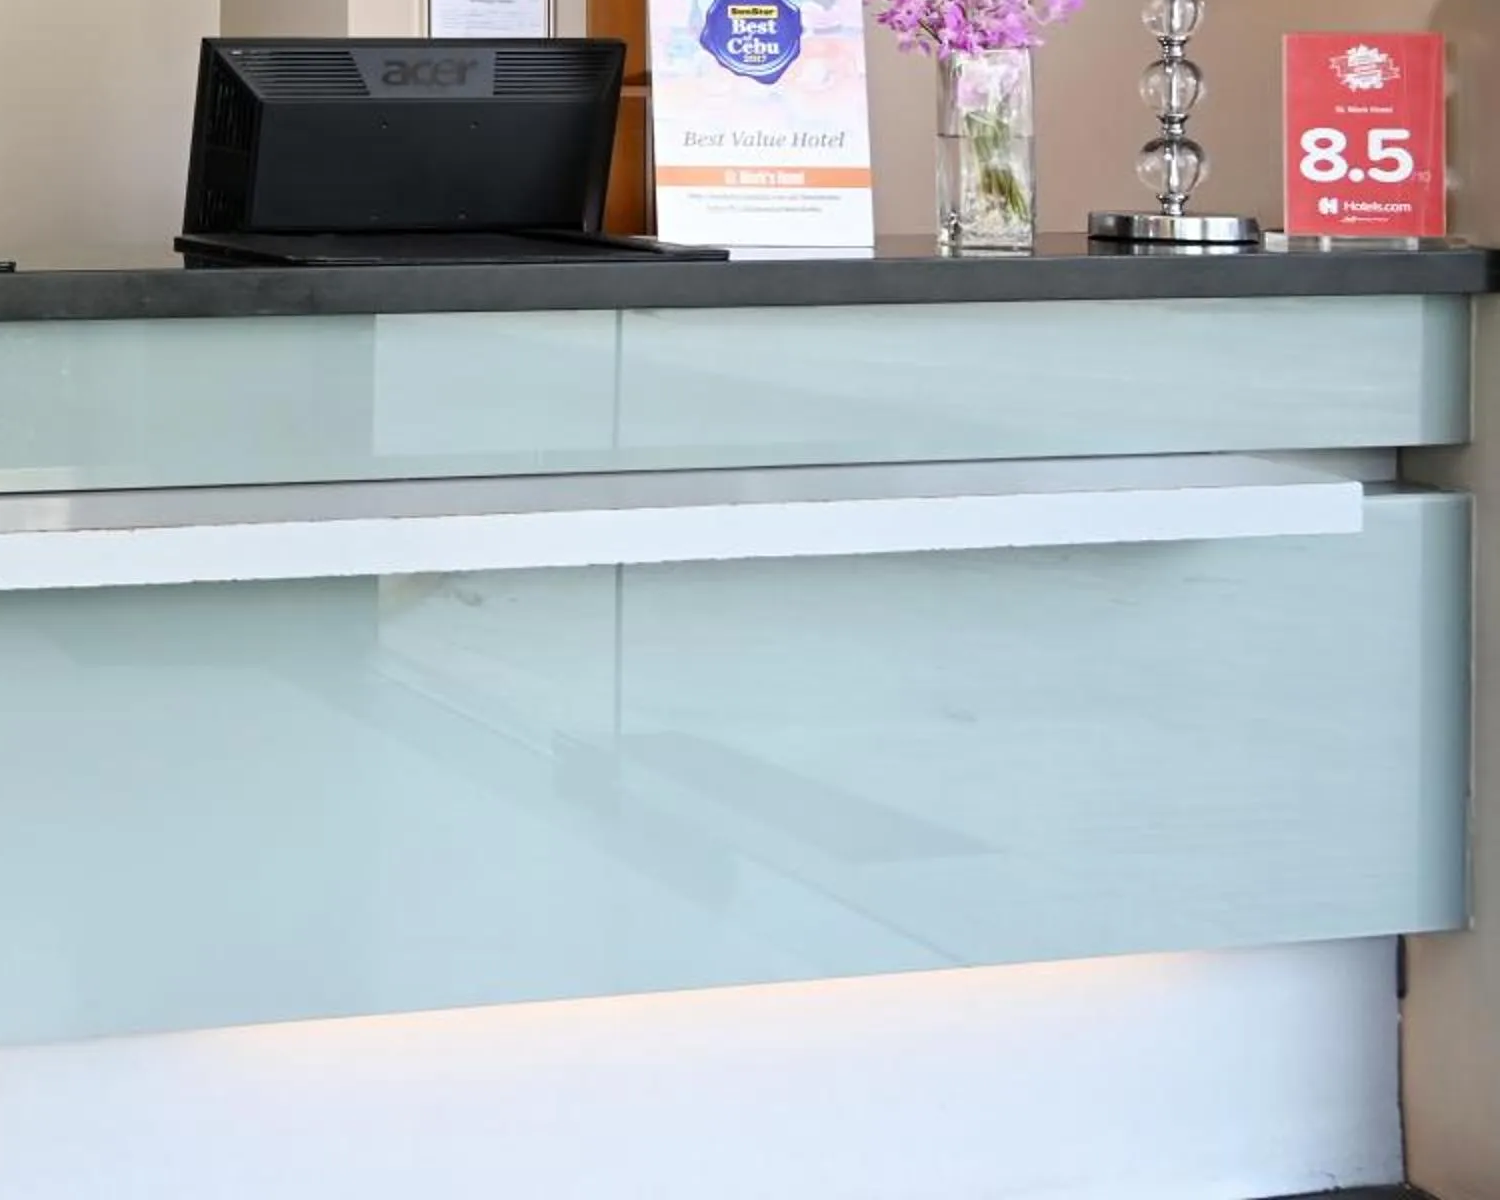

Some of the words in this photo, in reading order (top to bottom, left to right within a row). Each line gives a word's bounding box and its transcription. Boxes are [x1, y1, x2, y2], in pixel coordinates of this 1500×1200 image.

[732, 19, 777, 35] Best
[727, 38, 779, 55] Cebu
[381, 58, 479, 88] acer
[683, 131, 725, 147] Best
[732, 131, 786, 148] Value
[792, 131, 846, 148] Hotel
[1300, 127, 1414, 184] 8.5
[1344, 200, 1412, 212] Hotels.com
